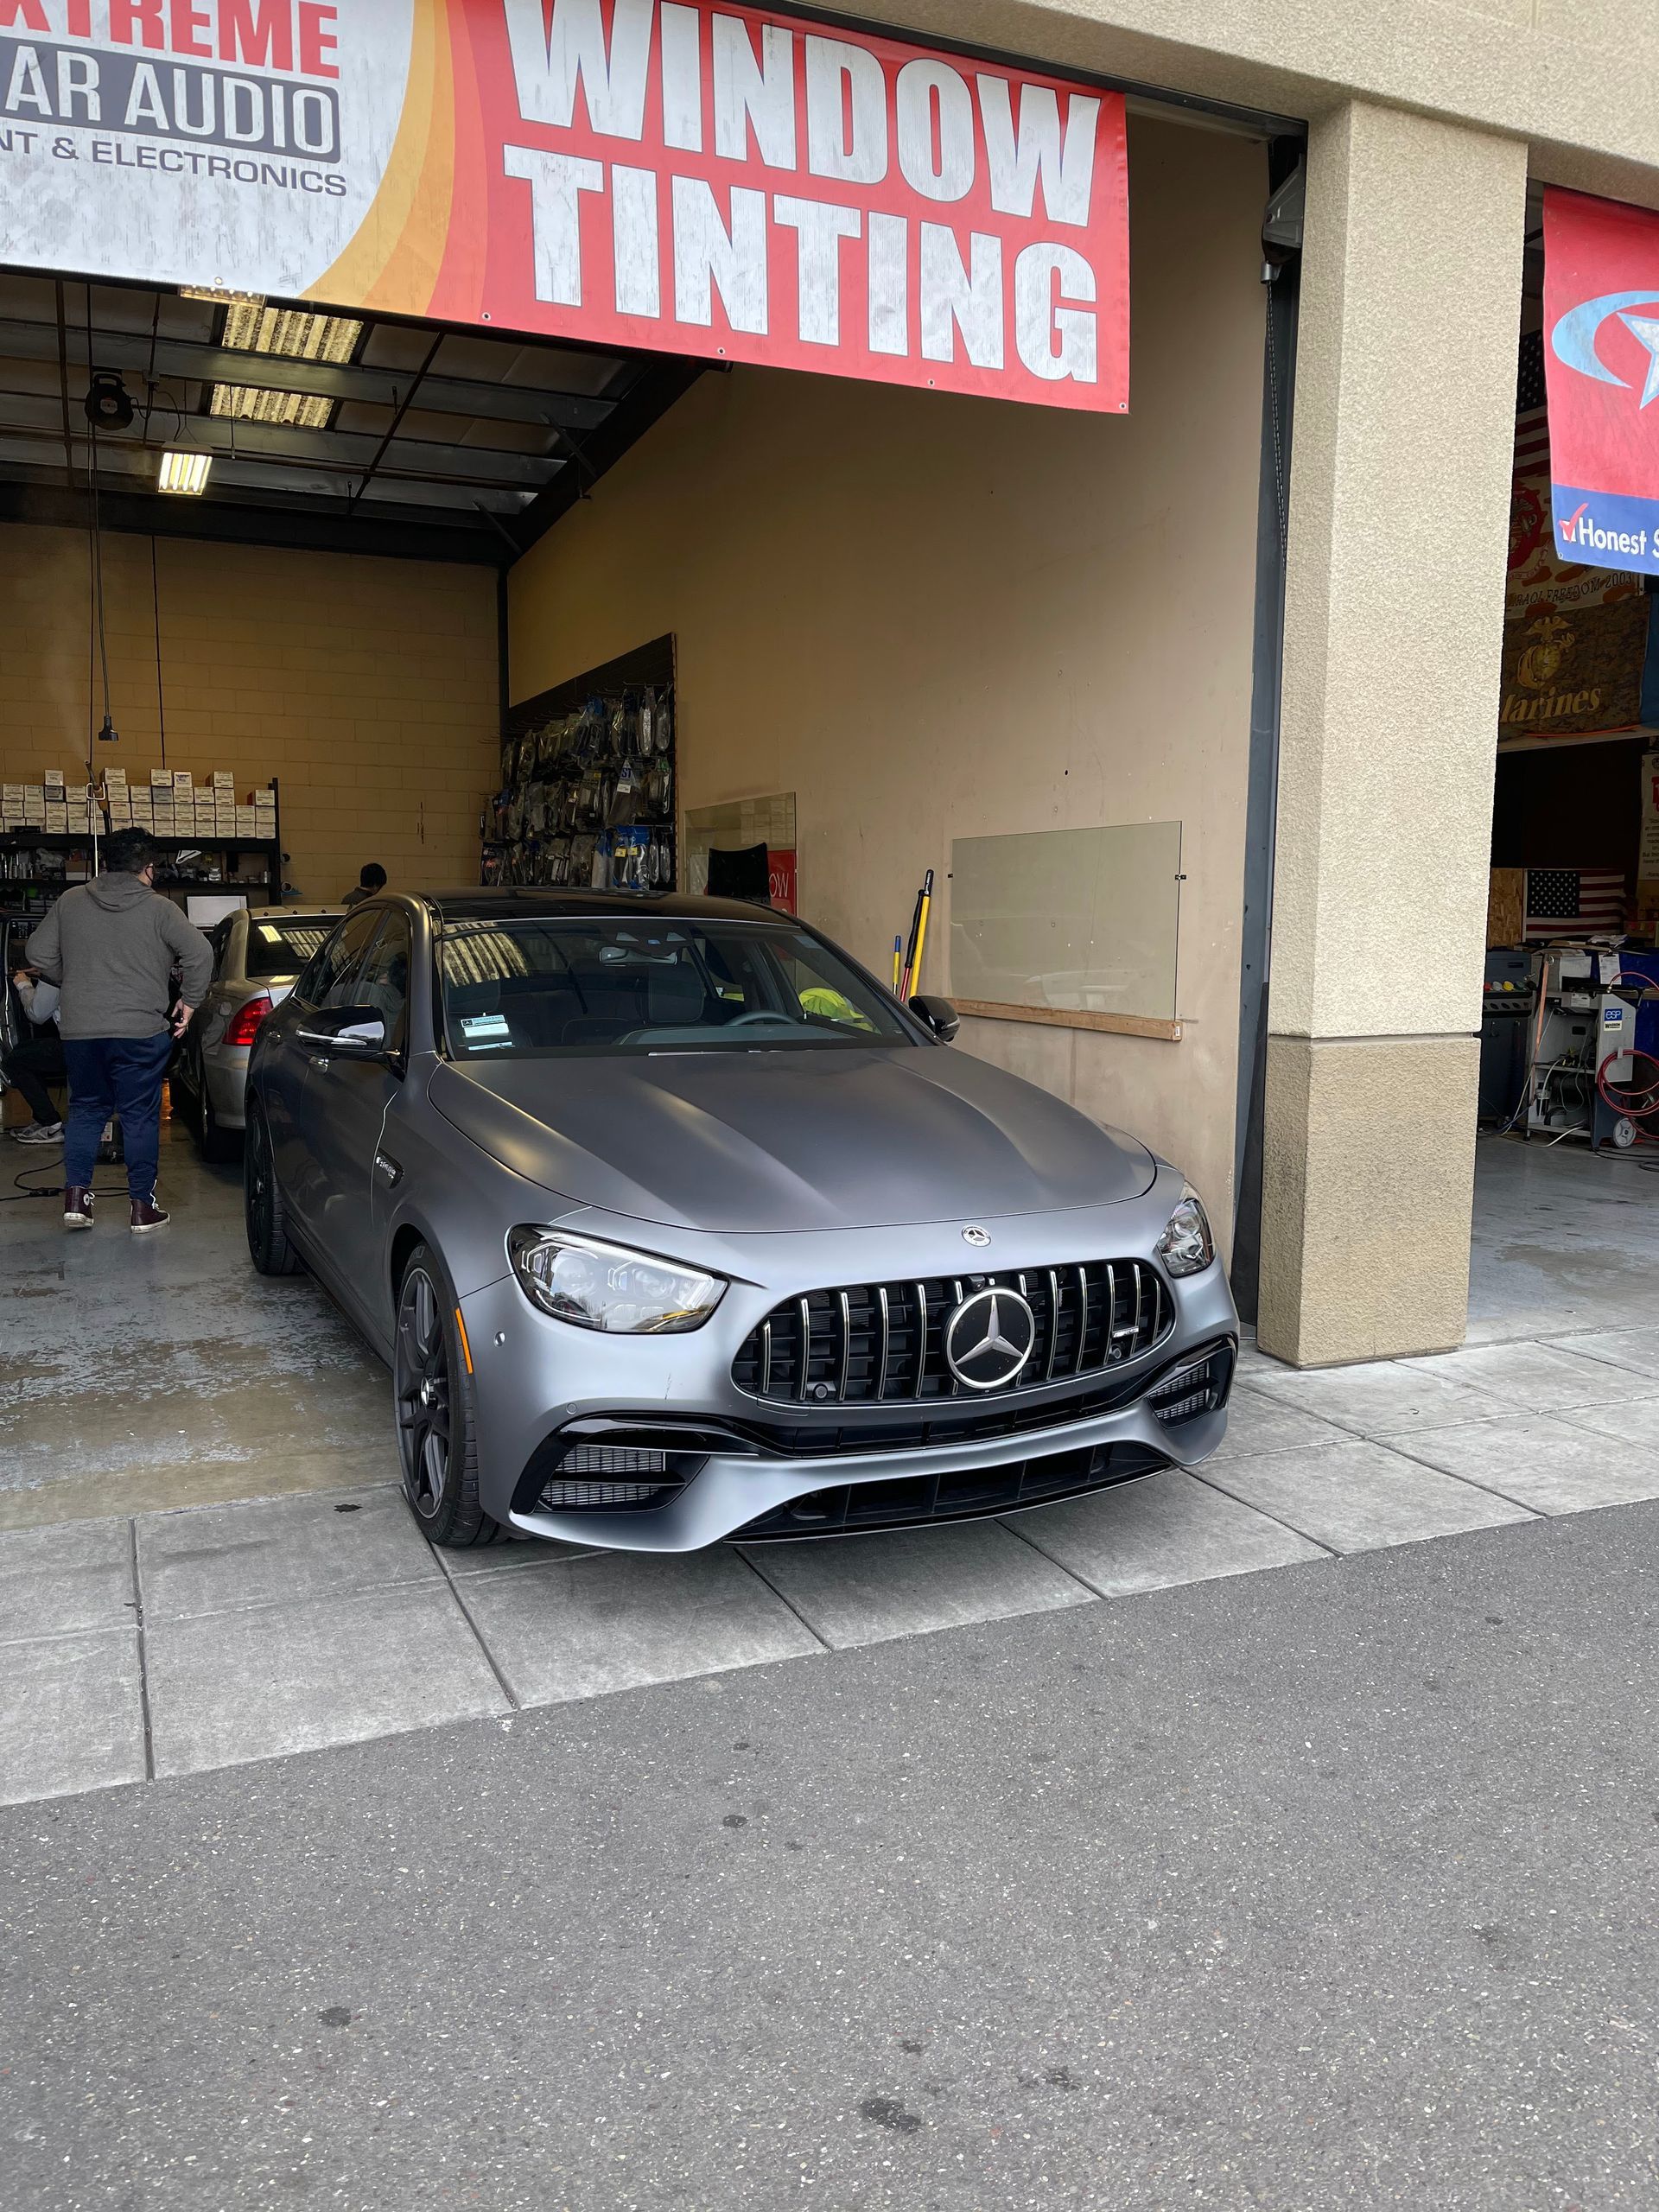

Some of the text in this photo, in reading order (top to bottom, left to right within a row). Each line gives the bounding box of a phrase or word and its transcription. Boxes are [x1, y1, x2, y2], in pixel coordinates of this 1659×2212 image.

[4, 45, 335, 155] AR AUDIO
[503, 0, 1102, 228] WINDOW
[52, 137, 79, 160] &
[92, 140, 347, 197] ELECTRONICS
[502, 143, 1098, 385] TINTING
[1578, 516, 1647, 556] Honest
